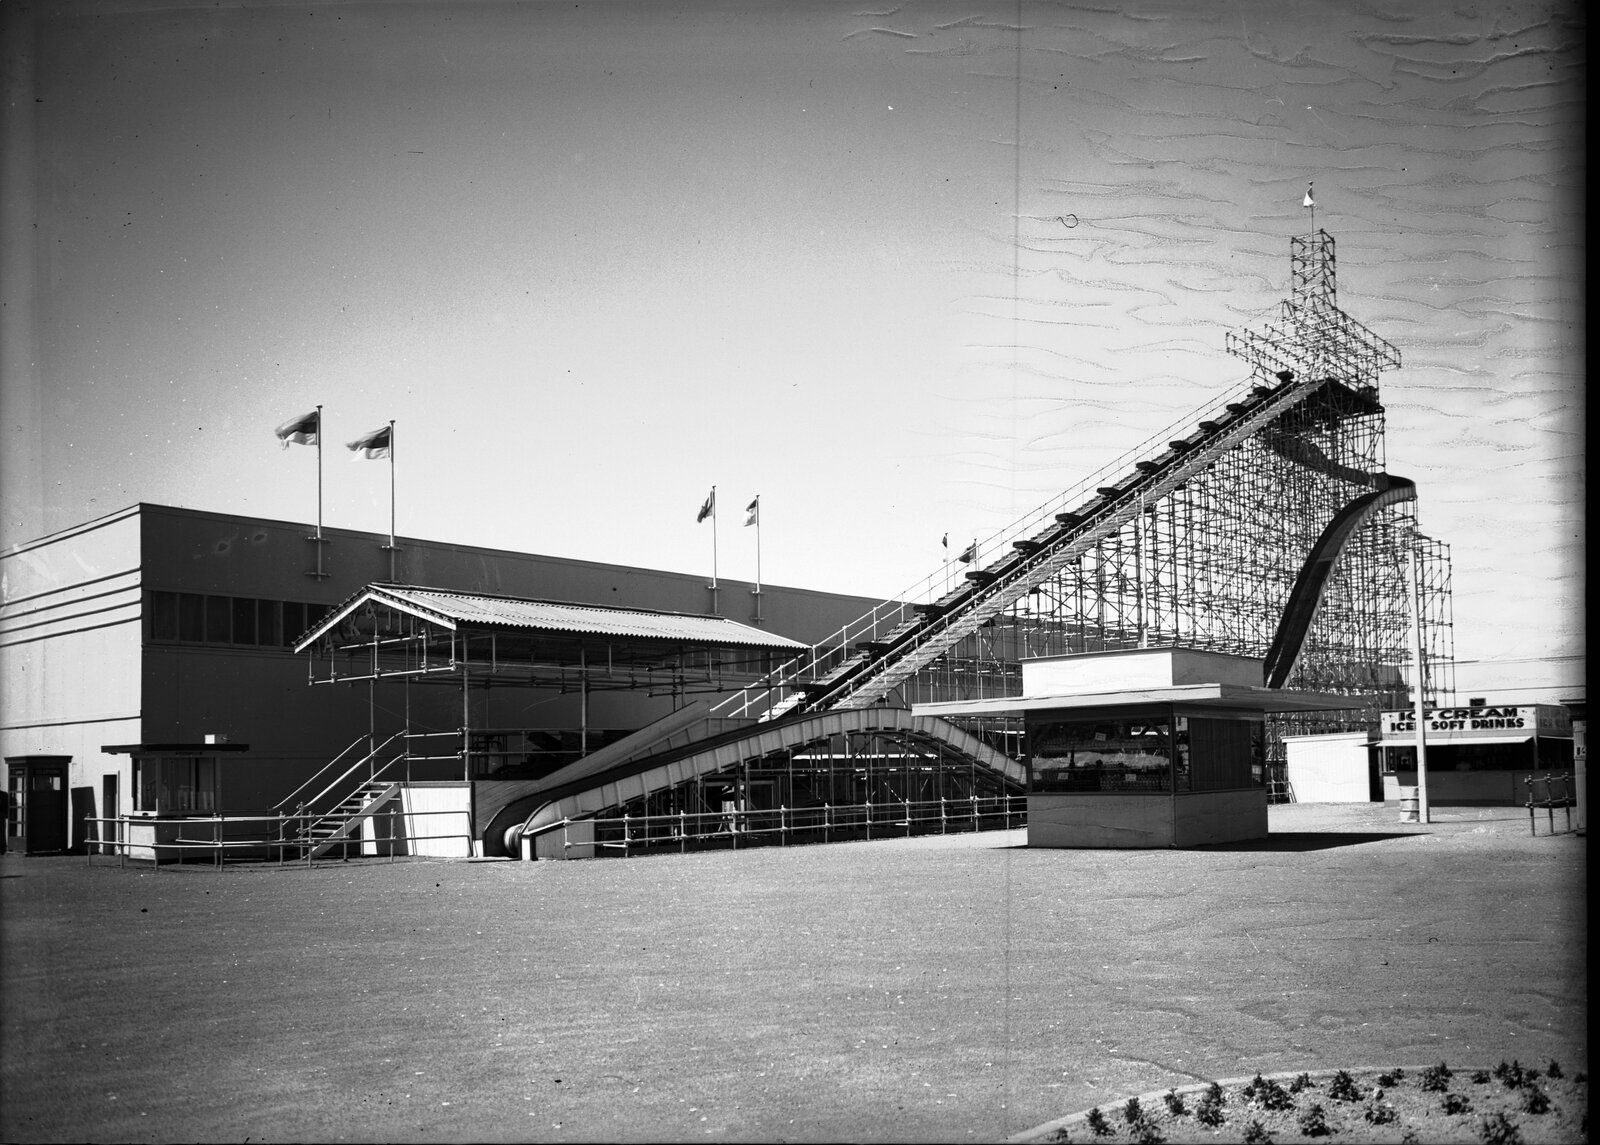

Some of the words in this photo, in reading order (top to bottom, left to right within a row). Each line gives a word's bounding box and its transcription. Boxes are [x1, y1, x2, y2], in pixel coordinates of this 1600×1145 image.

[1399, 711, 1434, 721] ICE
[1438, 708, 1518, 720] CREAM
[1391, 722, 1417, 732] ICE
[1431, 720, 1465, 730] SOFT
[1471, 718, 1525, 729] DRINKS
